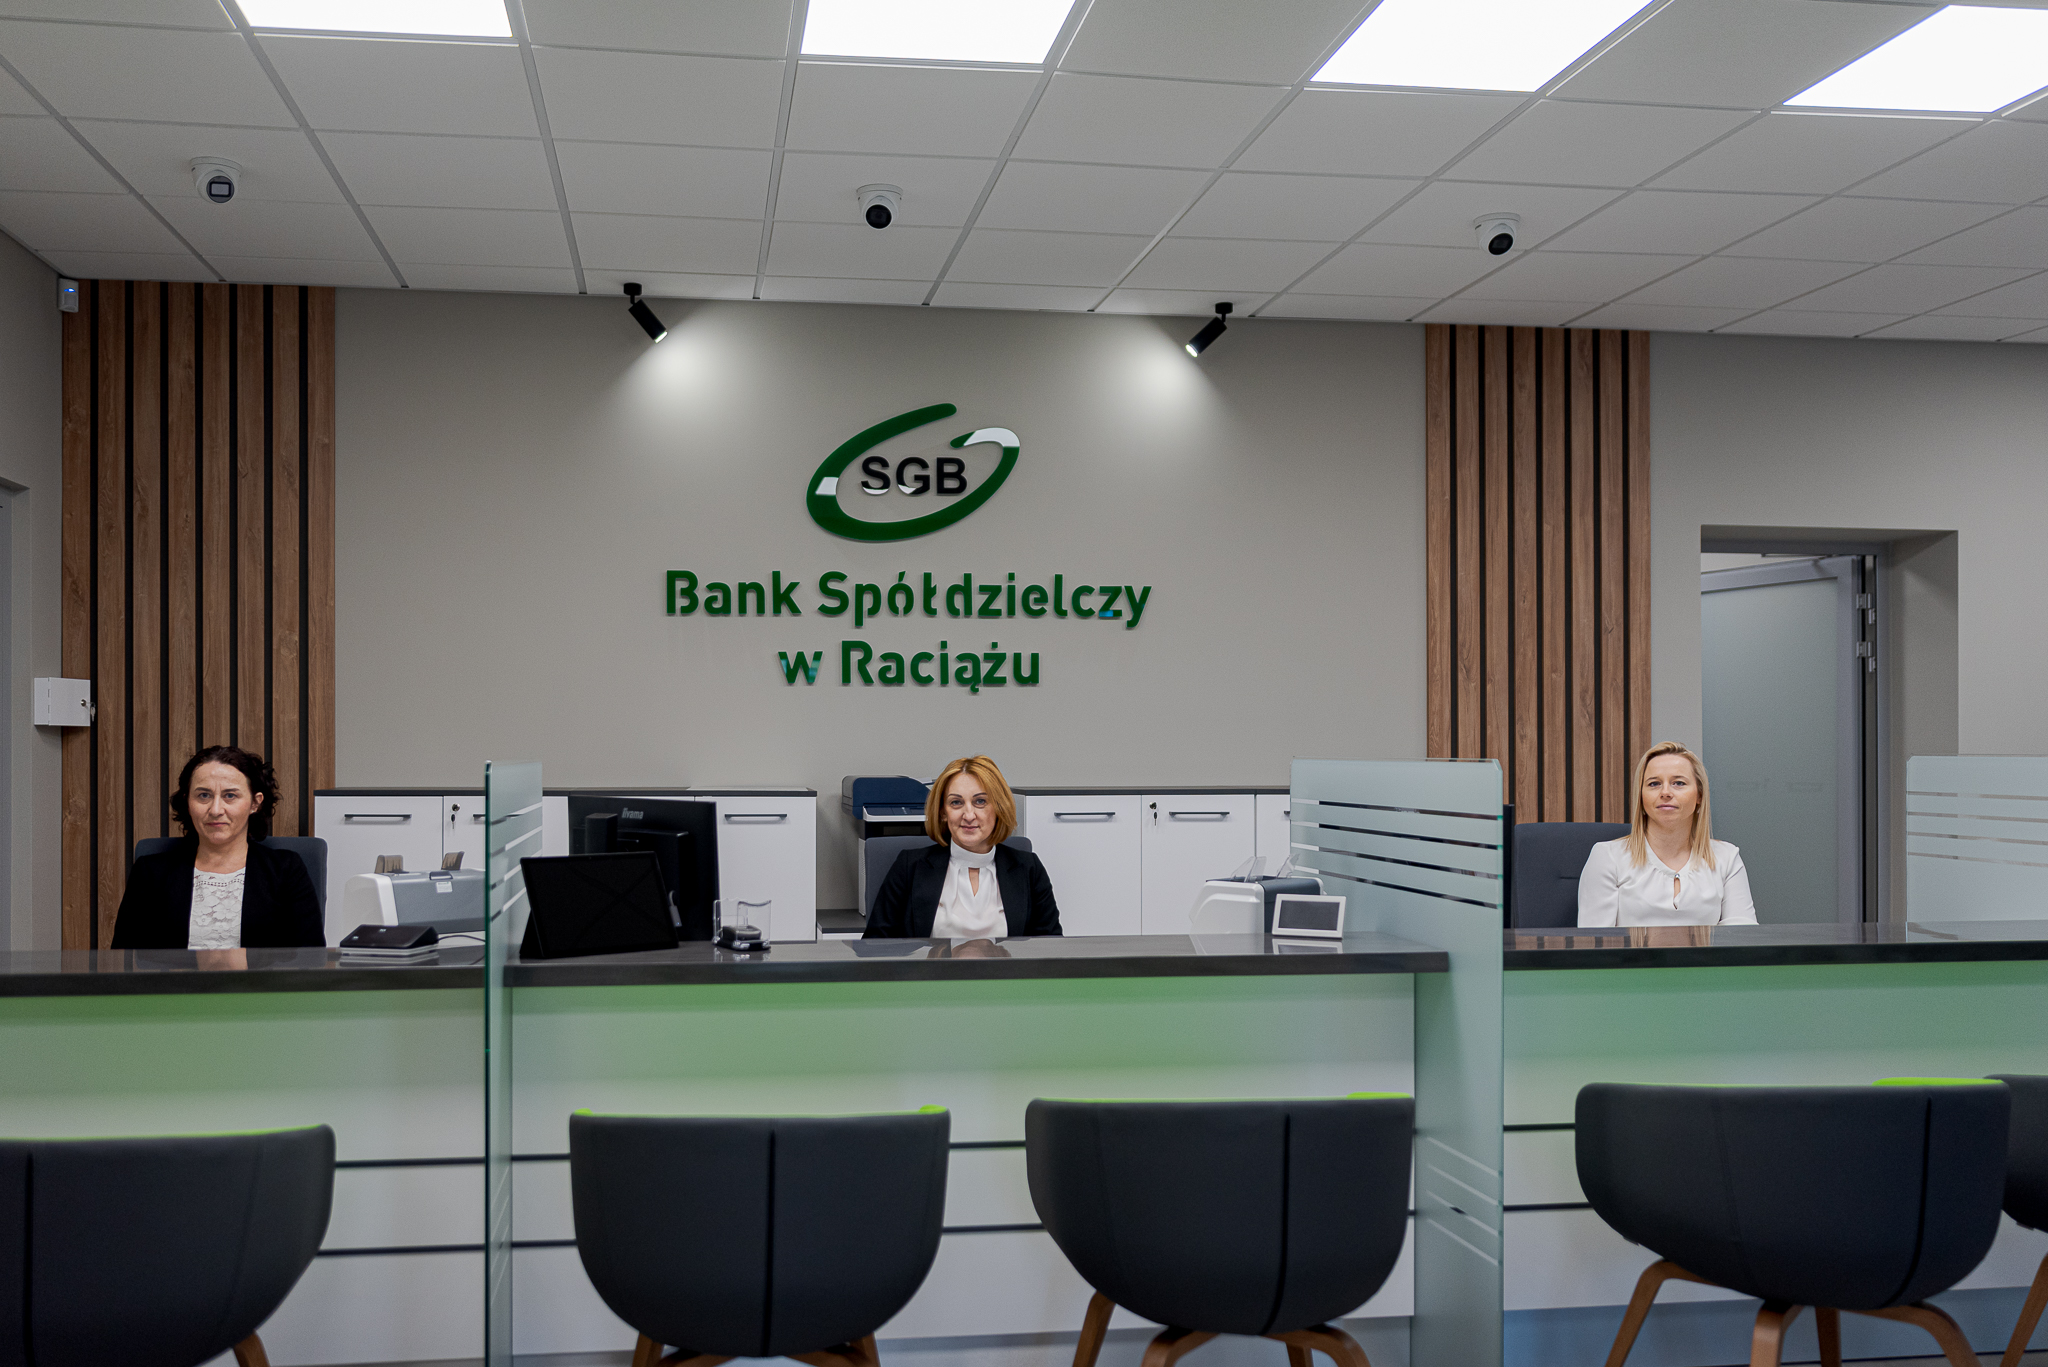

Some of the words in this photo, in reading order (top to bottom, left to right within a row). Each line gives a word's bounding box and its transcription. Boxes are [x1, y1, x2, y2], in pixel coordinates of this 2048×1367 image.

[860, 456, 968, 496] SGB
[666, 570, 802, 617] Bank
[818, 571, 1152, 629] Spółdzielczy
[778, 650, 824, 685] w
[841, 640, 1040, 694] Raciążu
